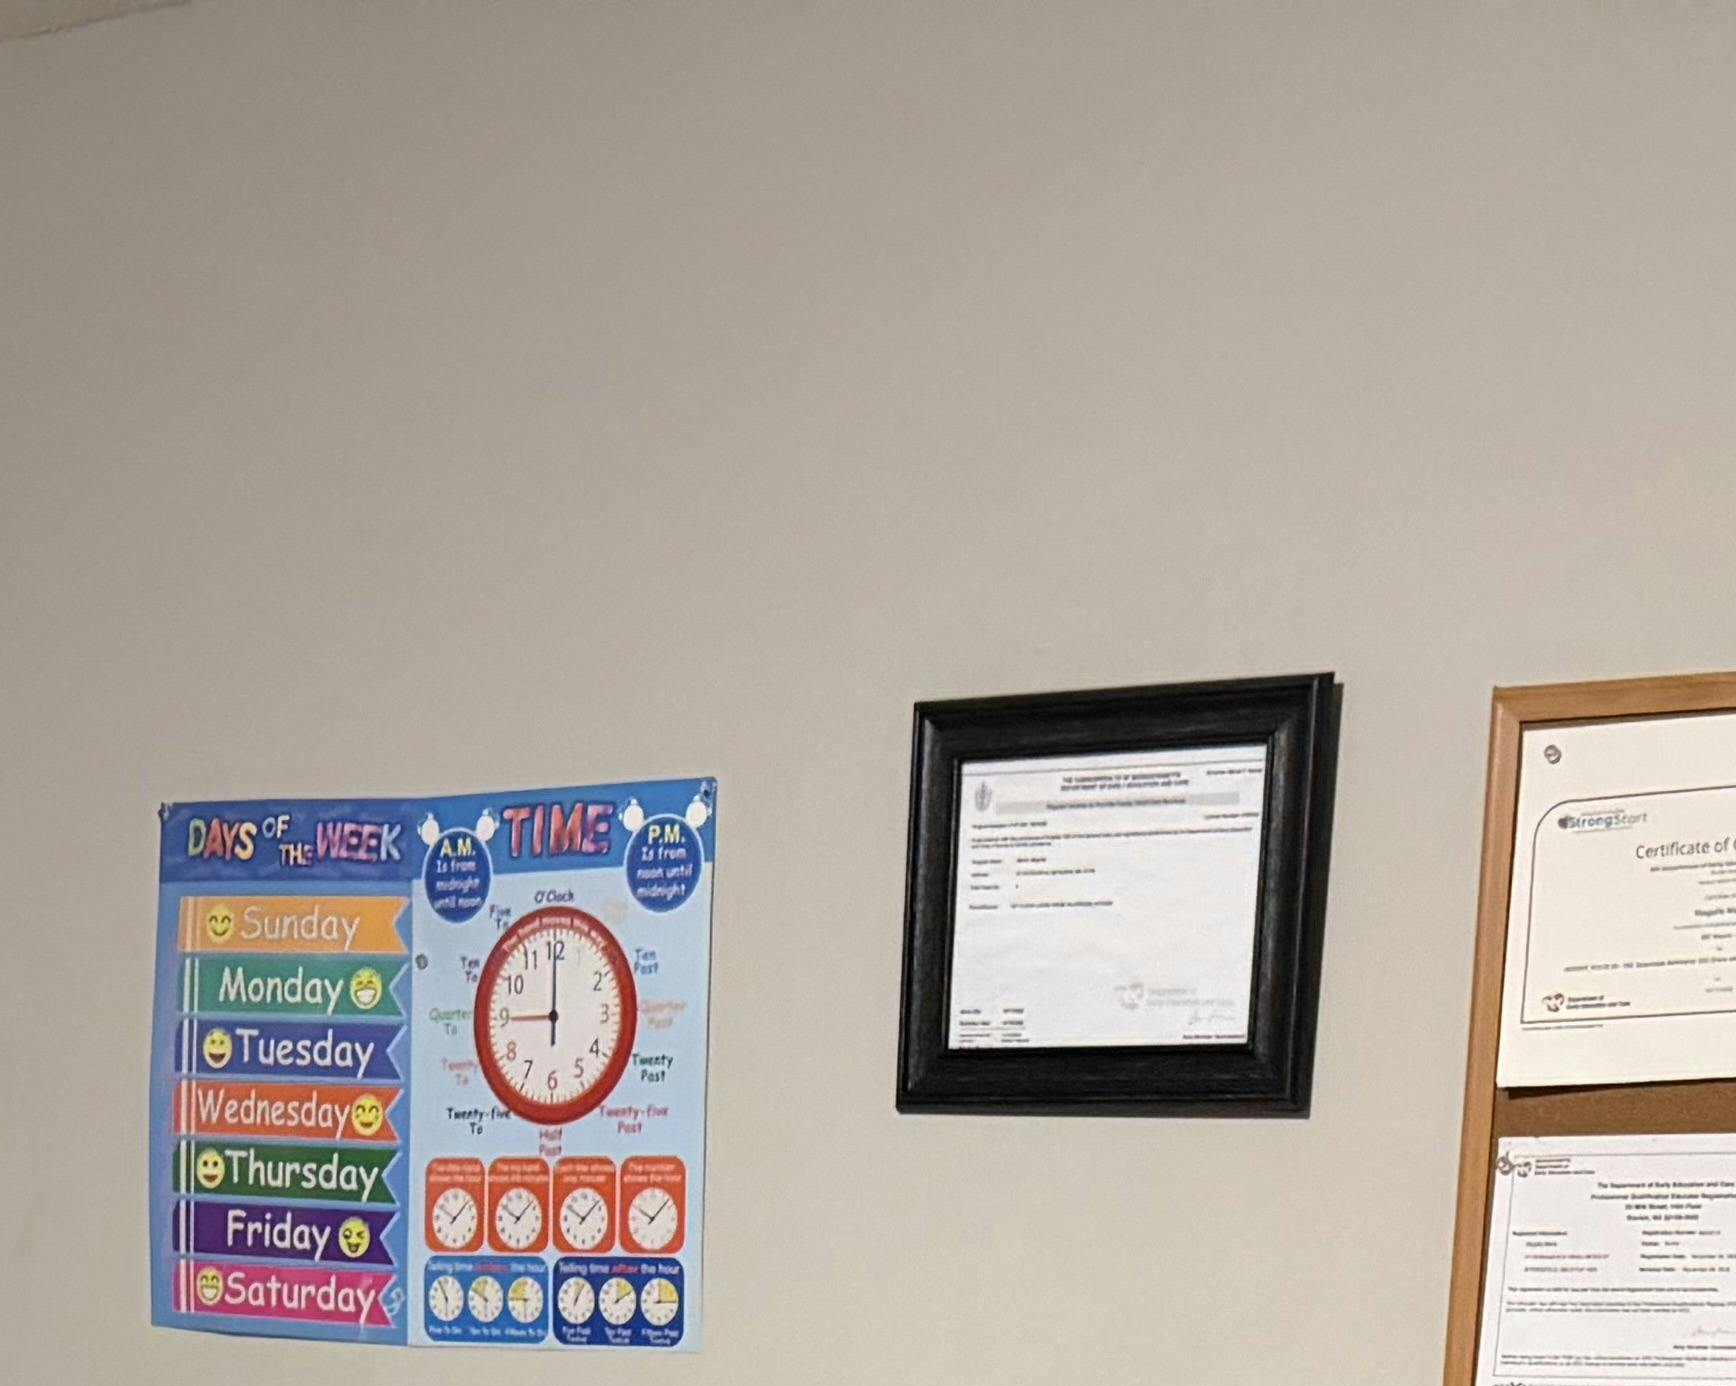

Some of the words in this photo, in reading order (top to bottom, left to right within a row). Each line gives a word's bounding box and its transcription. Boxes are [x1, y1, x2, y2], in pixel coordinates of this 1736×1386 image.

[187, 817, 257, 861] DAYS
[262, 814, 290, 838] OF
[278, 842, 313, 866] THE
[316, 821, 401, 861] WEEK
[502, 801, 614, 858] TIME
[648, 824, 686, 845] P.M.
[440, 838, 476, 857] A.M.
[1636, 842, 1709, 859] Certificate
[1714, 838, 1730, 853] of
[240, 905, 361, 950] Sunday
[219, 966, 343, 1016] Monday
[508, 976, 524, 994] 10
[235, 1028, 375, 1079] Tuesday
[506, 1042, 517, 1060] 8
[590, 1038, 600, 1058] 4
[632, 1054, 673, 1068] Twenty
[548, 1071, 558, 1090] 6
[641, 1069, 666, 1082] Past
[197, 1087, 350, 1140] Wednesday
[225, 1148, 379, 1202] Thursday
[227, 1210, 331, 1262] Friday
[225, 1272, 376, 1325] Saturday
